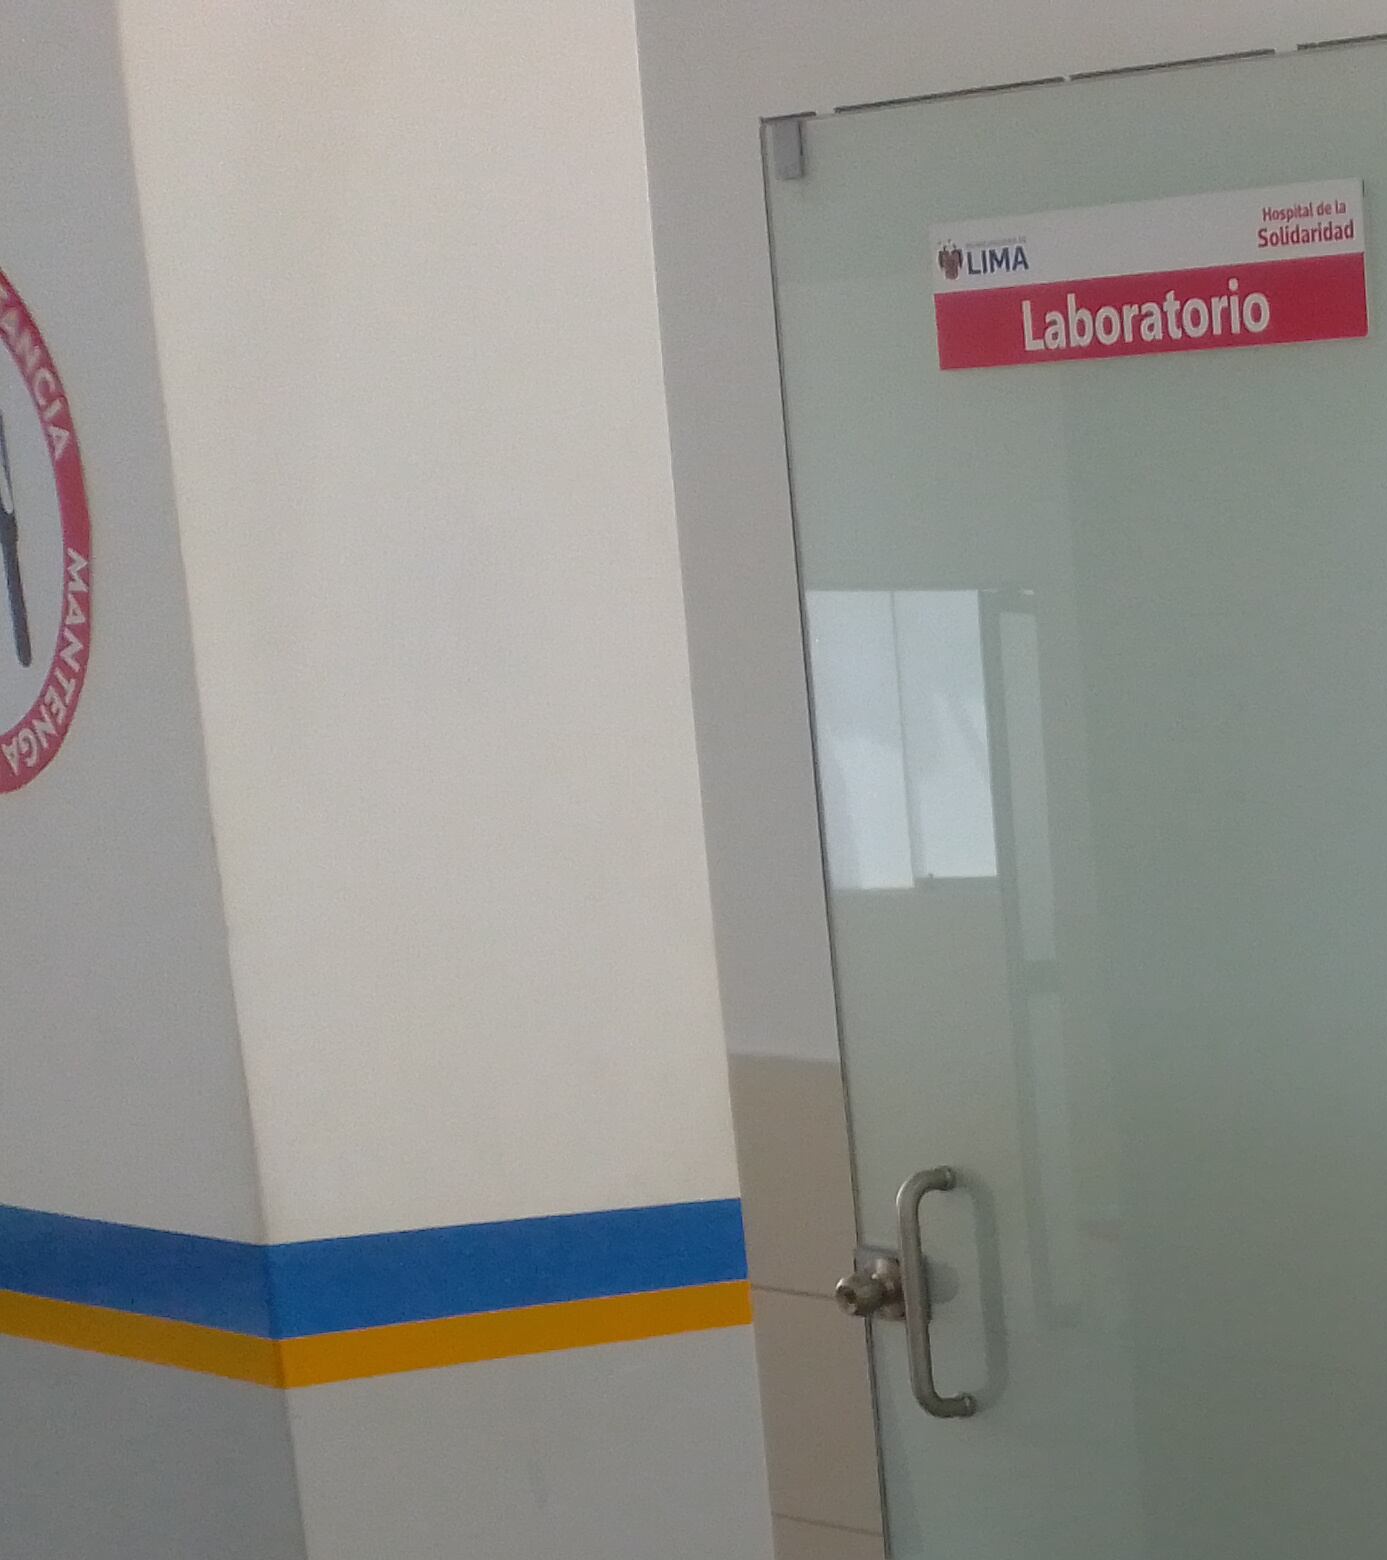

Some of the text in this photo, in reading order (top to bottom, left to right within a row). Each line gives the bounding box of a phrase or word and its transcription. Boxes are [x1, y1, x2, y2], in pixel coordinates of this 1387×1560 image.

[1262, 199, 1346, 222] Hospital de la
[1258, 219, 1354, 248] Solidaridad
[967, 245, 1029, 275] LIMA
[1022, 277, 1271, 352] Laboratorio
[1, 546, 89, 777] MANTENGA
